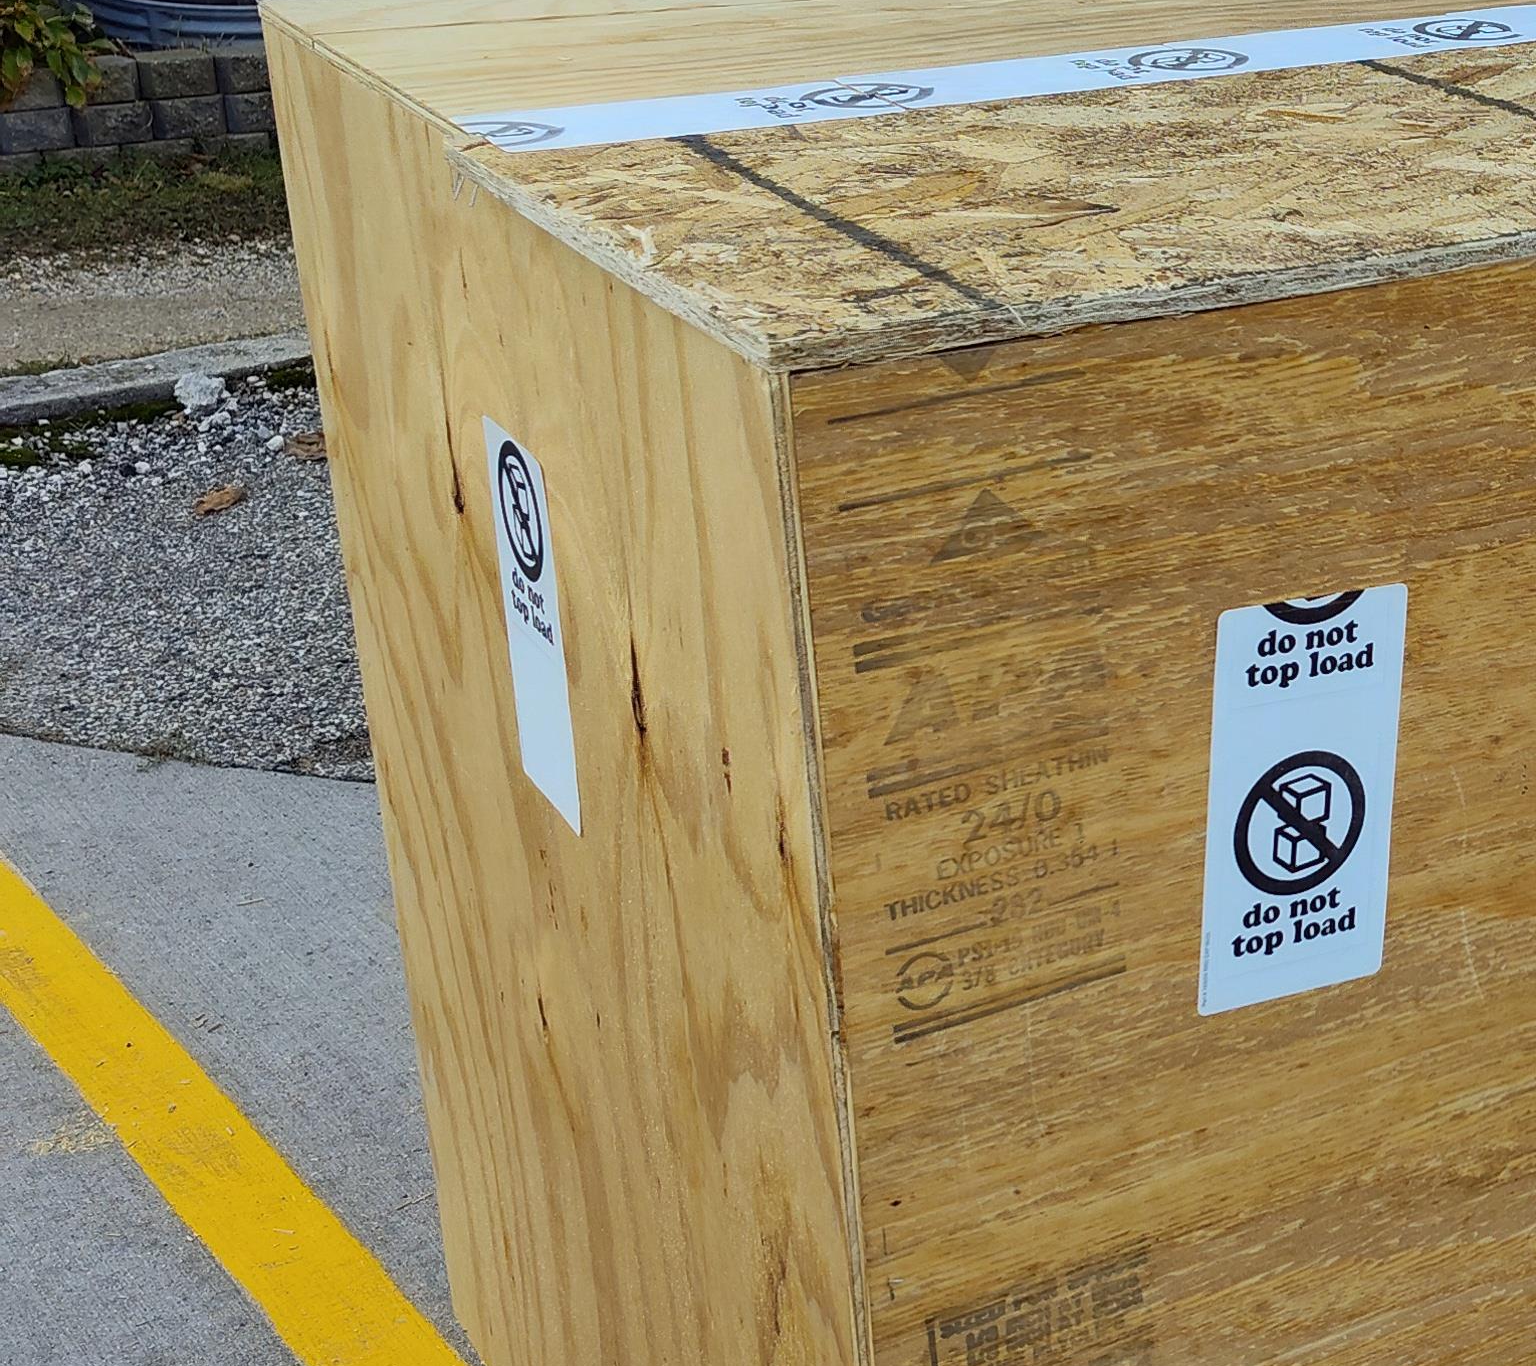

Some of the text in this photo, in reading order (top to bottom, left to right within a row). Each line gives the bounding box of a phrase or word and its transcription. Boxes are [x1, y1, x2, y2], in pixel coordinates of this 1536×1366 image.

[512, 567, 545, 614] do not
[511, 589, 555, 646] top load
[1257, 618, 1358, 658] do not
[1246, 643, 1375, 688] top load
[885, 747, 1109, 821] RATED SHEATHIN
[937, 827, 1061, 880] EXPOSURE
[884, 867, 1020, 921] THICKNESS
[1242, 887, 1340, 929] do not
[1232, 908, 1357, 958] top load
